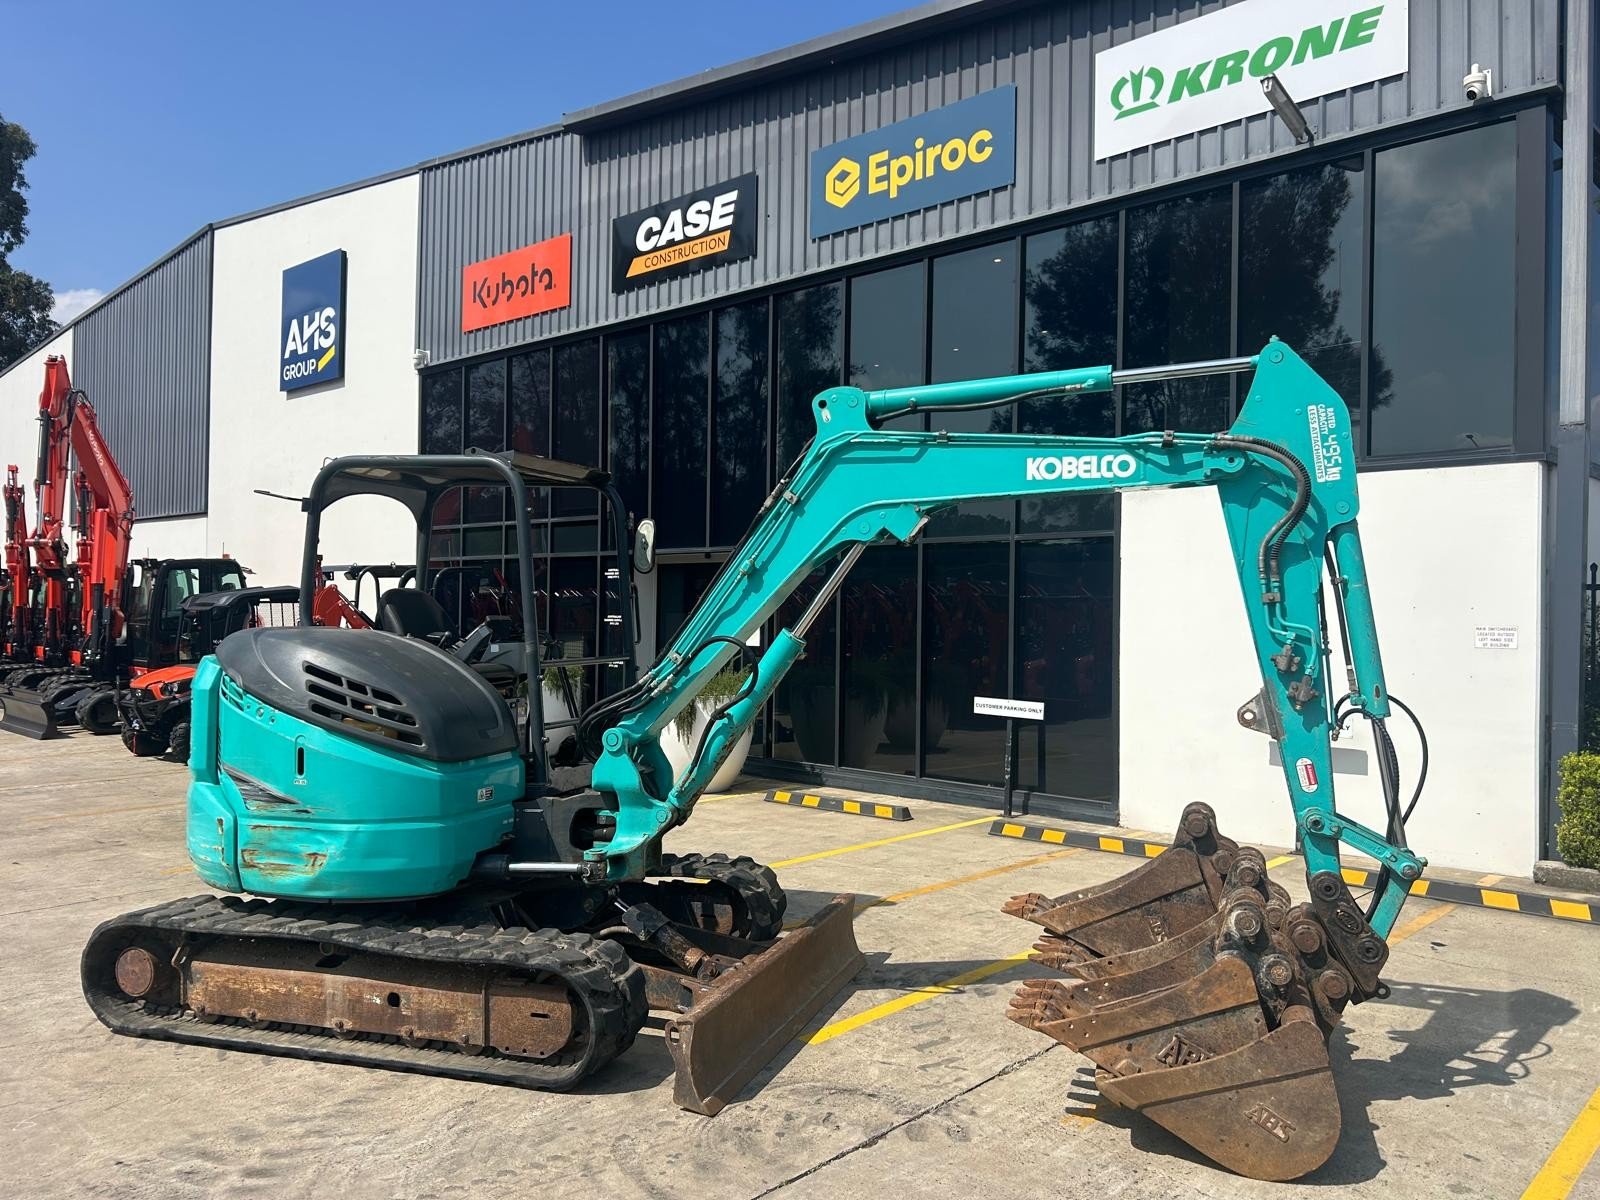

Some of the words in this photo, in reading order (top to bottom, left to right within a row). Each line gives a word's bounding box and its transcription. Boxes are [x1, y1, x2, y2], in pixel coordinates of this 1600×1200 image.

[1167, 5, 1384, 104] KRONE
[868, 129, 993, 199] Epiroc
[636, 190, 738, 251] CASE
[644, 235, 726, 268] CONSTRUCTION
[473, 262, 553, 309] Kubota
[284, 307, 336, 358] AHS
[283, 359, 316, 380] GROUP
[1309, 408, 1317, 425] LESS
[1318, 404, 1328, 434] CAPACITY
[1327, 408, 1336, 428] RATED
[1026, 454, 1137, 480] KOBELCO
[1312, 427, 1324, 479] ATTACHMENTS
